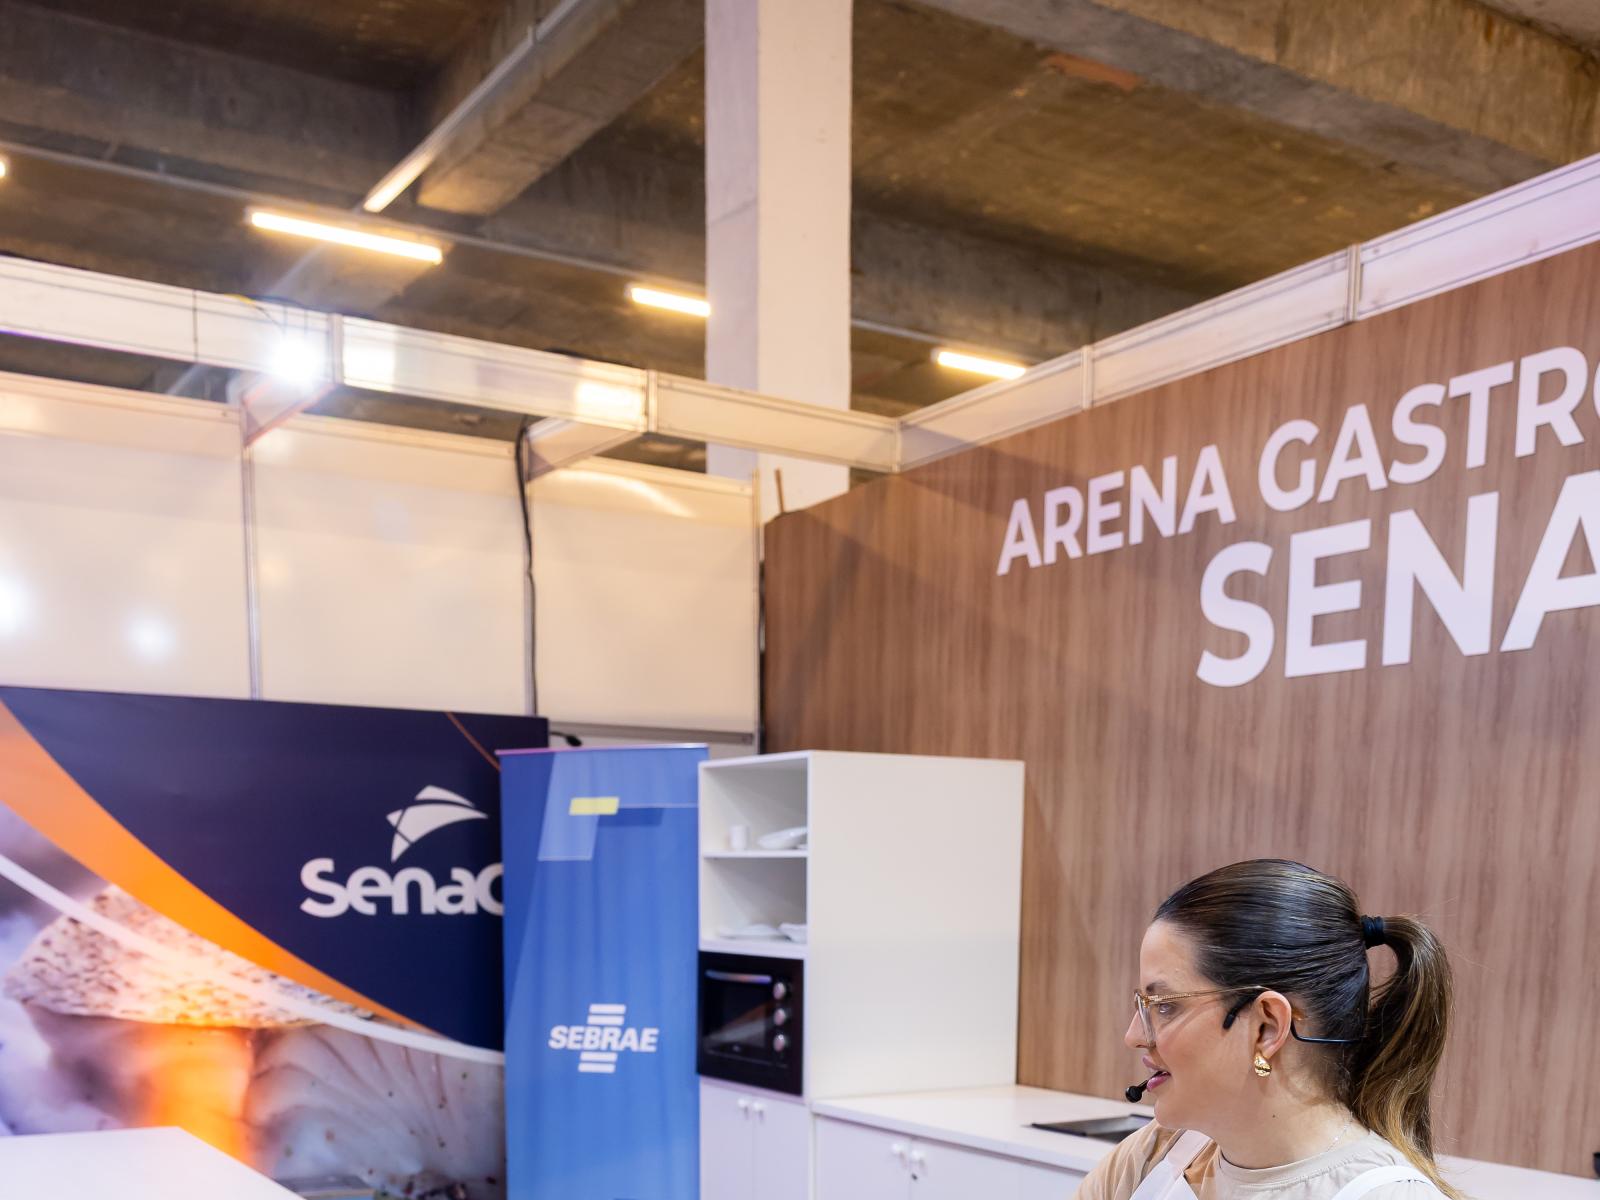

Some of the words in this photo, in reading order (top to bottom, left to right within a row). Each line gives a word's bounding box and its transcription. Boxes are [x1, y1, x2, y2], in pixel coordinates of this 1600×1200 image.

[997, 445, 1236, 576] ARENA
[1258, 346, 1600, 511] GASTR
[1196, 470, 1600, 687] SENA
[300, 857, 504, 918] Senac
[548, 1025, 659, 1052] SEBRAE
